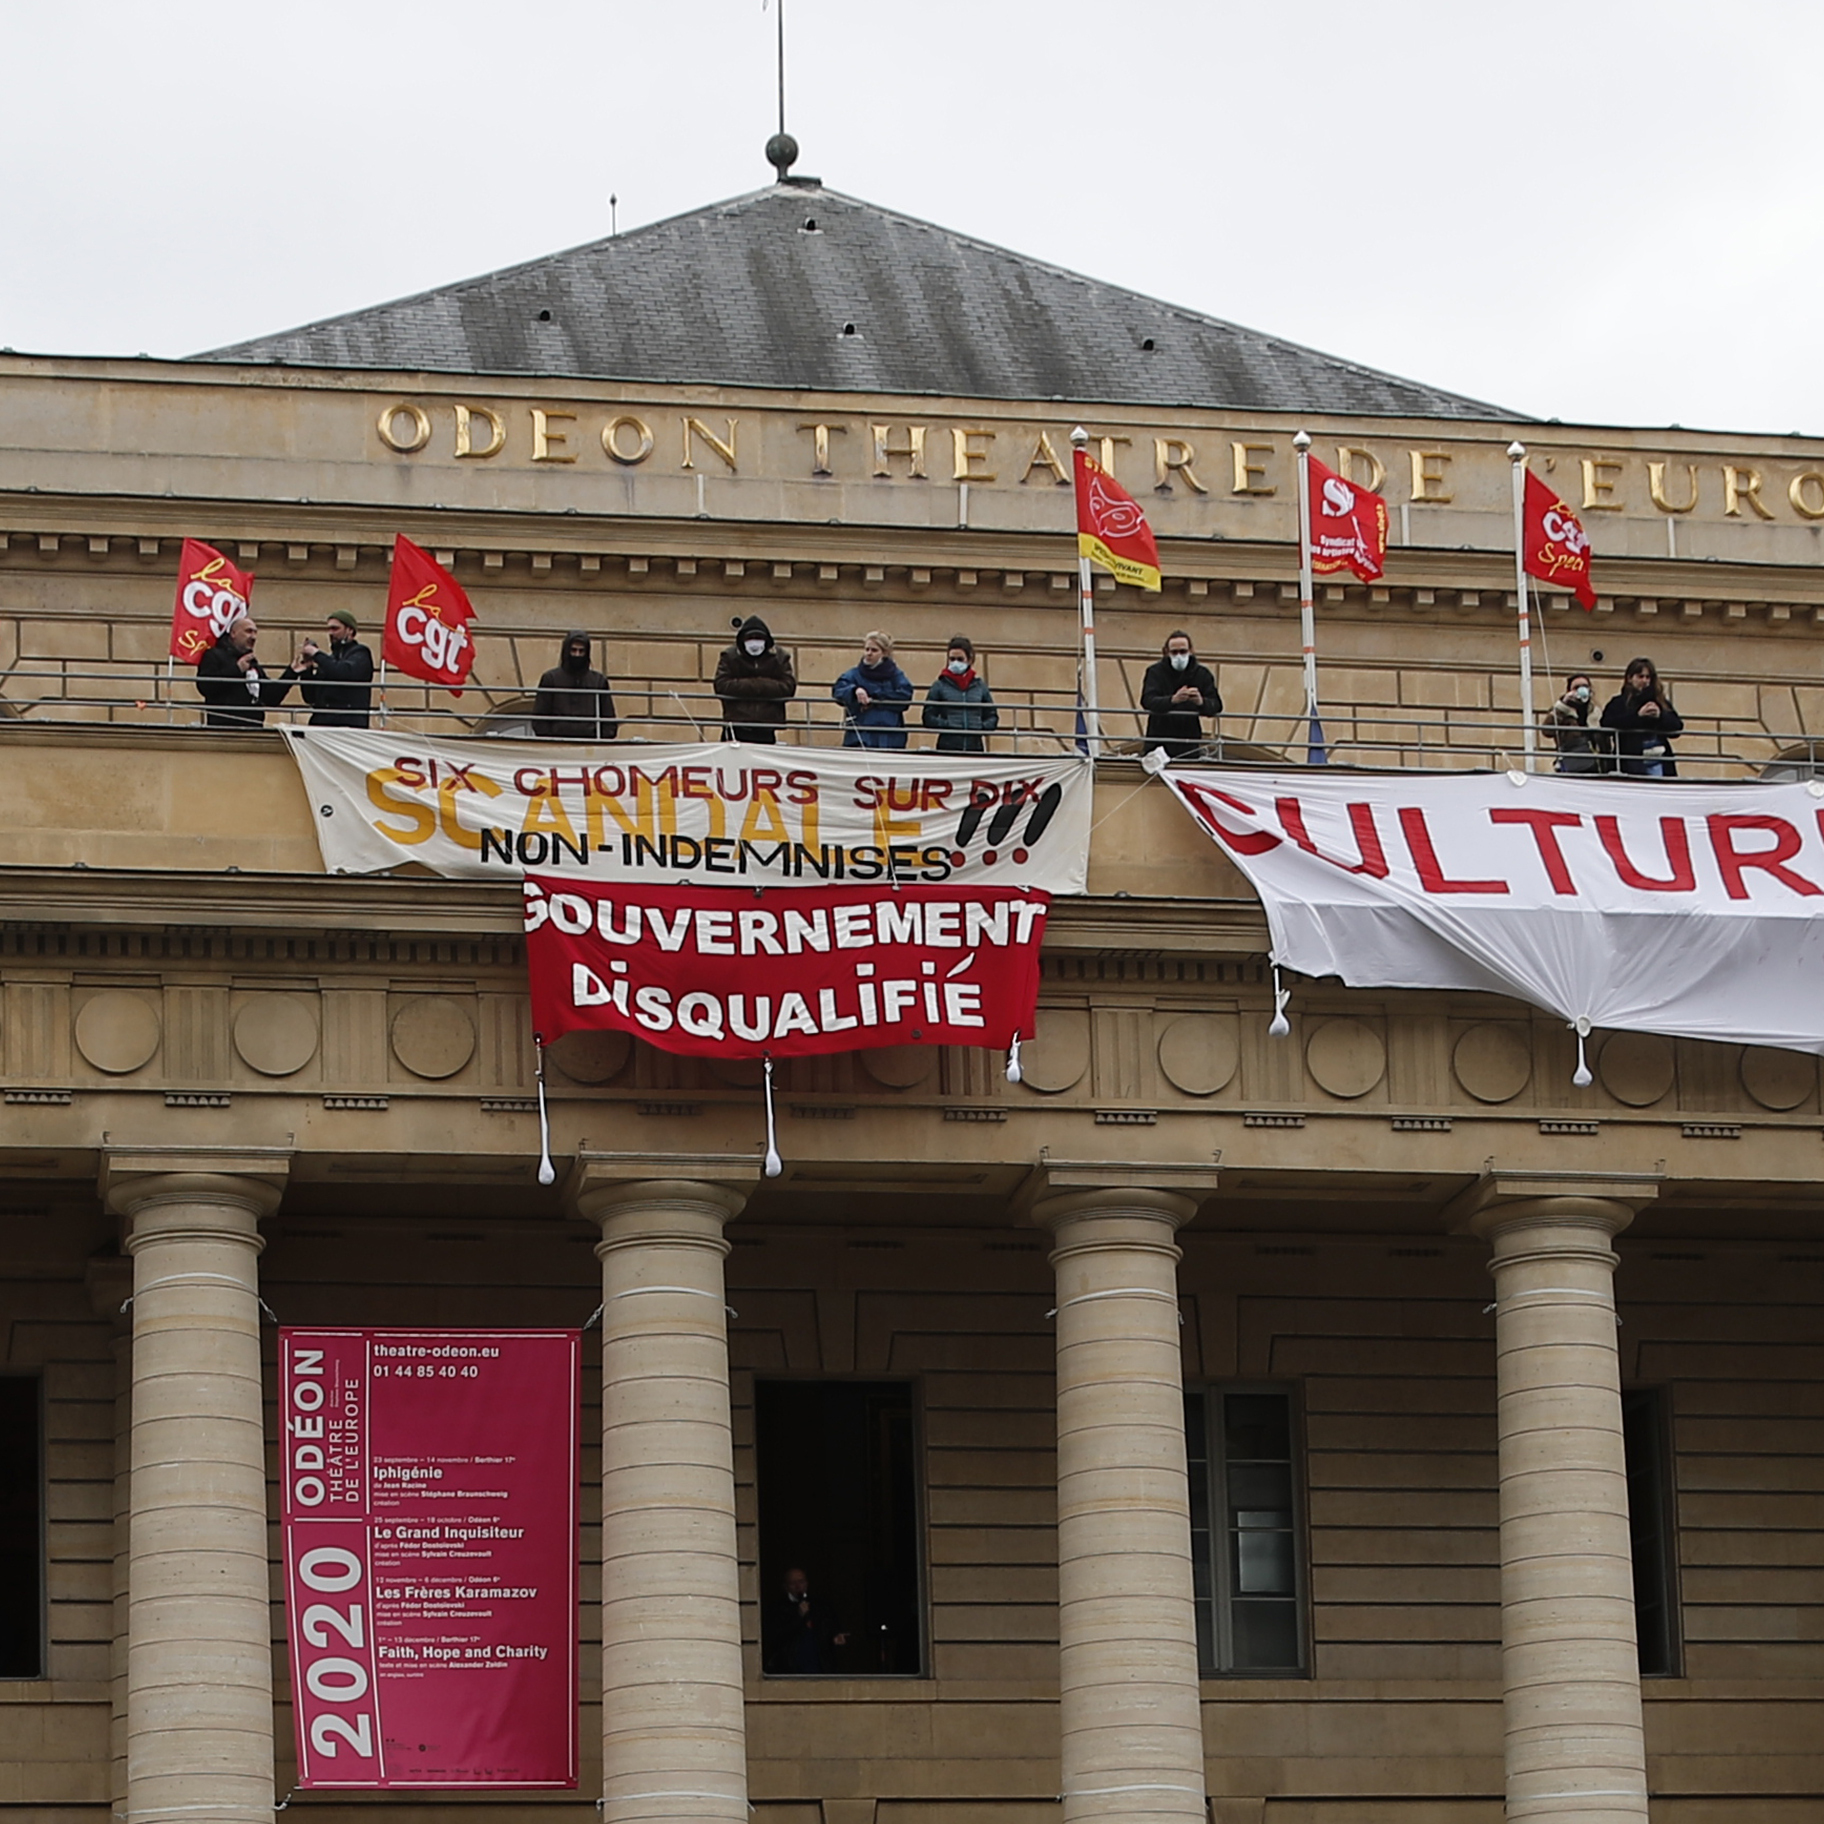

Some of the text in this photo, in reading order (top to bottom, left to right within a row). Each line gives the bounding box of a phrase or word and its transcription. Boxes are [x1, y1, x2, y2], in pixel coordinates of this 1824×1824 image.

[377, 402, 739, 472] ODEON
[796, 422, 1278, 497] THEATRE
[1337, 446, 1456, 502] DE
[396, 606, 468, 674] cgt
[393, 756, 479, 793] SIX
[852, 776, 954, 812] SUR
[969, 776, 1047, 811] DIX
[365, 766, 942, 868] SCANDALE
[480, 828, 953, 882] NON-INDEMNISES
[523, 881, 1048, 956] GOUVERNEMENT
[373, 1343, 500, 1358] theatre-odeon.eu
[373, 1365, 478, 1378] 01 44 85 40 40
[288, 1350, 325, 1507] ODÉON
[345, 1379, 359, 1502] DE L'EUROPE
[327, 1419, 343, 1502] THÉÂTRE
[373, 1466, 443, 1481] Iphigénie
[374, 1525, 524, 1541] Le Grand Inquisiteur
[376, 1586, 538, 1599] Les Frères Karamazov
[299, 1546, 374, 1759] 2020
[378, 1644, 548, 1661] Faith, Hope and Charity
